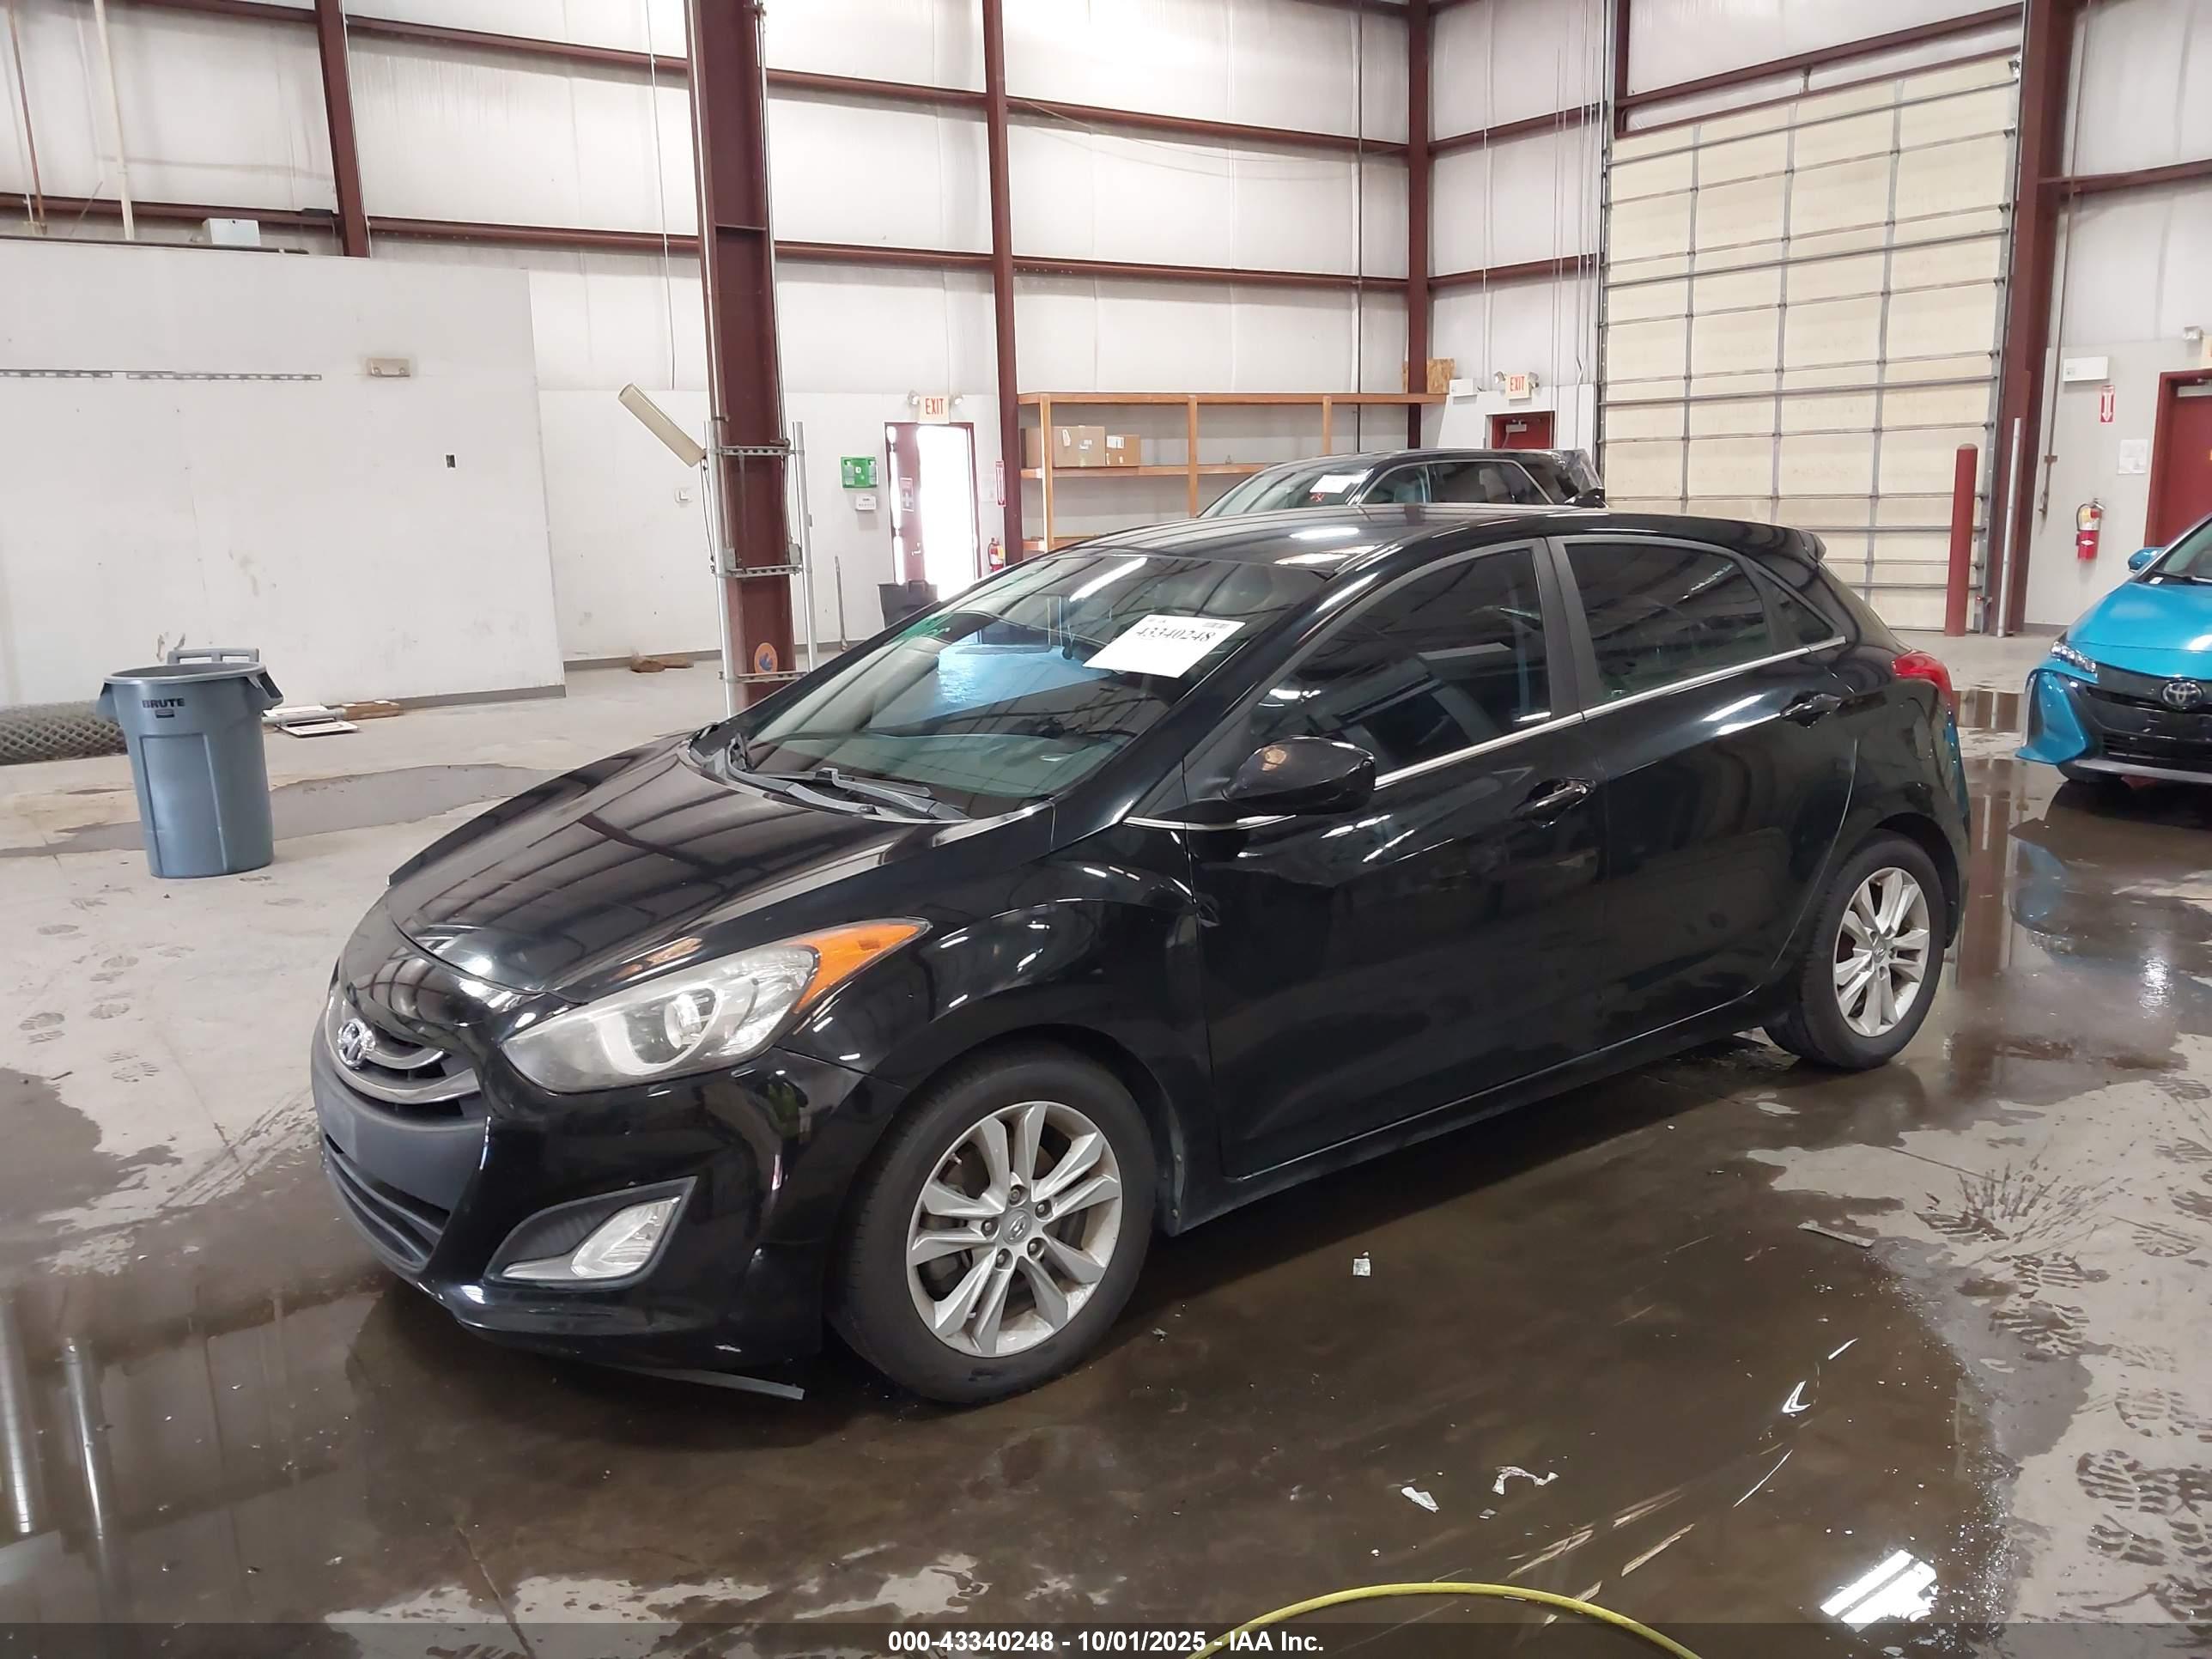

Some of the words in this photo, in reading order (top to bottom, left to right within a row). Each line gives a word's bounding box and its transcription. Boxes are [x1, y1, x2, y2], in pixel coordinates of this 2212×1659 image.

[1510, 376, 1525, 392] EXIT
[925, 398, 945, 415] EXIT
[1136, 626, 1217, 642] 43340248
[142, 697, 186, 708] BRUTE
